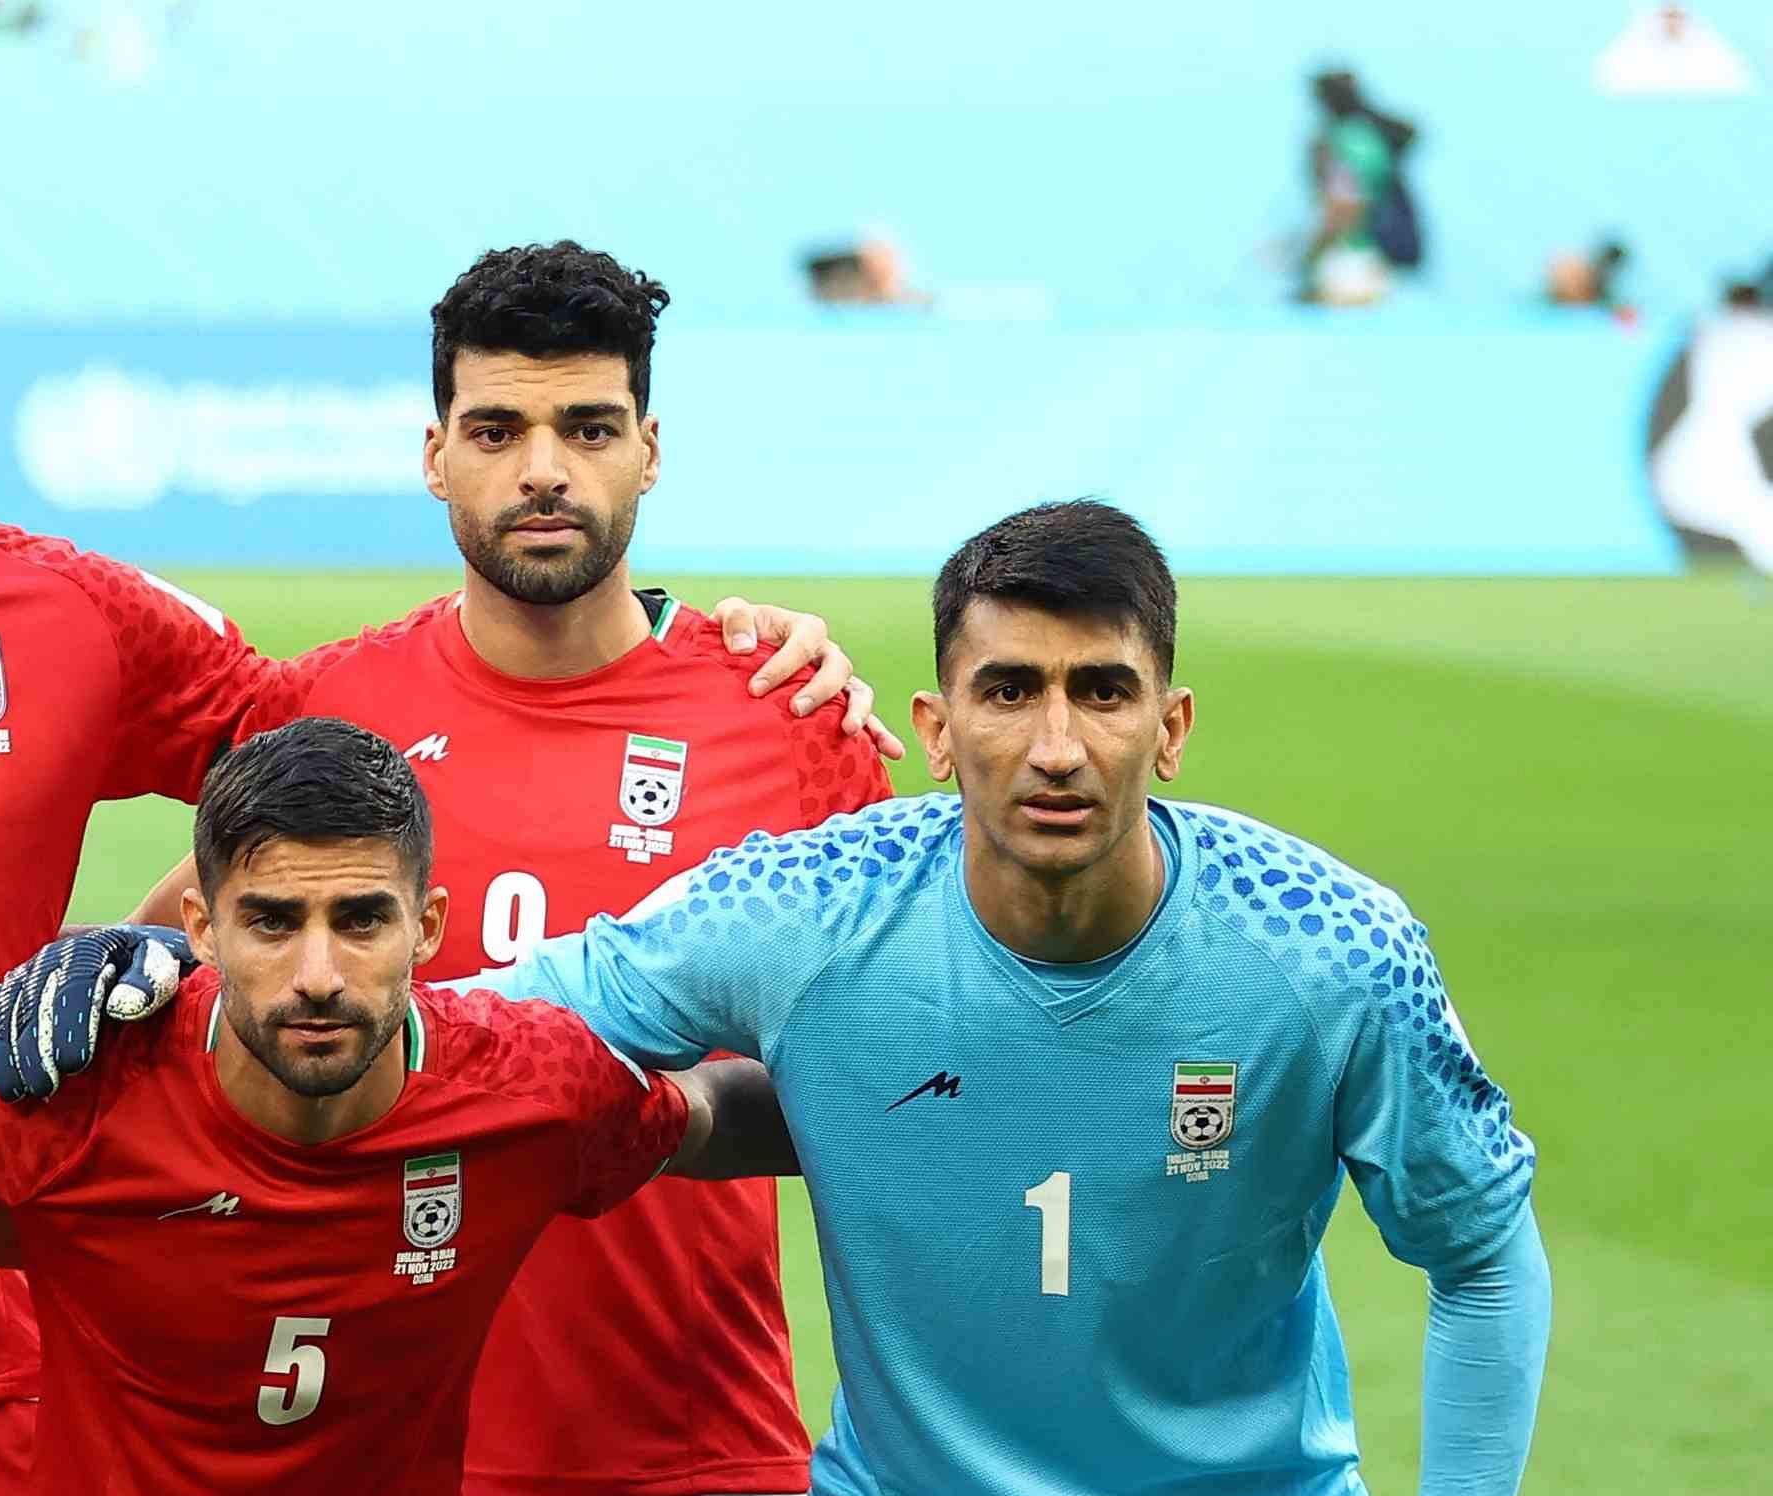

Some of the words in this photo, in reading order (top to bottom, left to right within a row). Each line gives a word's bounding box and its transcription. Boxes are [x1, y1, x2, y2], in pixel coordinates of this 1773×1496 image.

[480, 871, 546, 977] 9
[393, 1263, 406, 1275] 21
[407, 1262, 429, 1274] NOV
[429, 1259, 455, 1272] 2022
[1026, 1171, 1071, 1296] 1
[257, 1316, 332, 1426] 5
